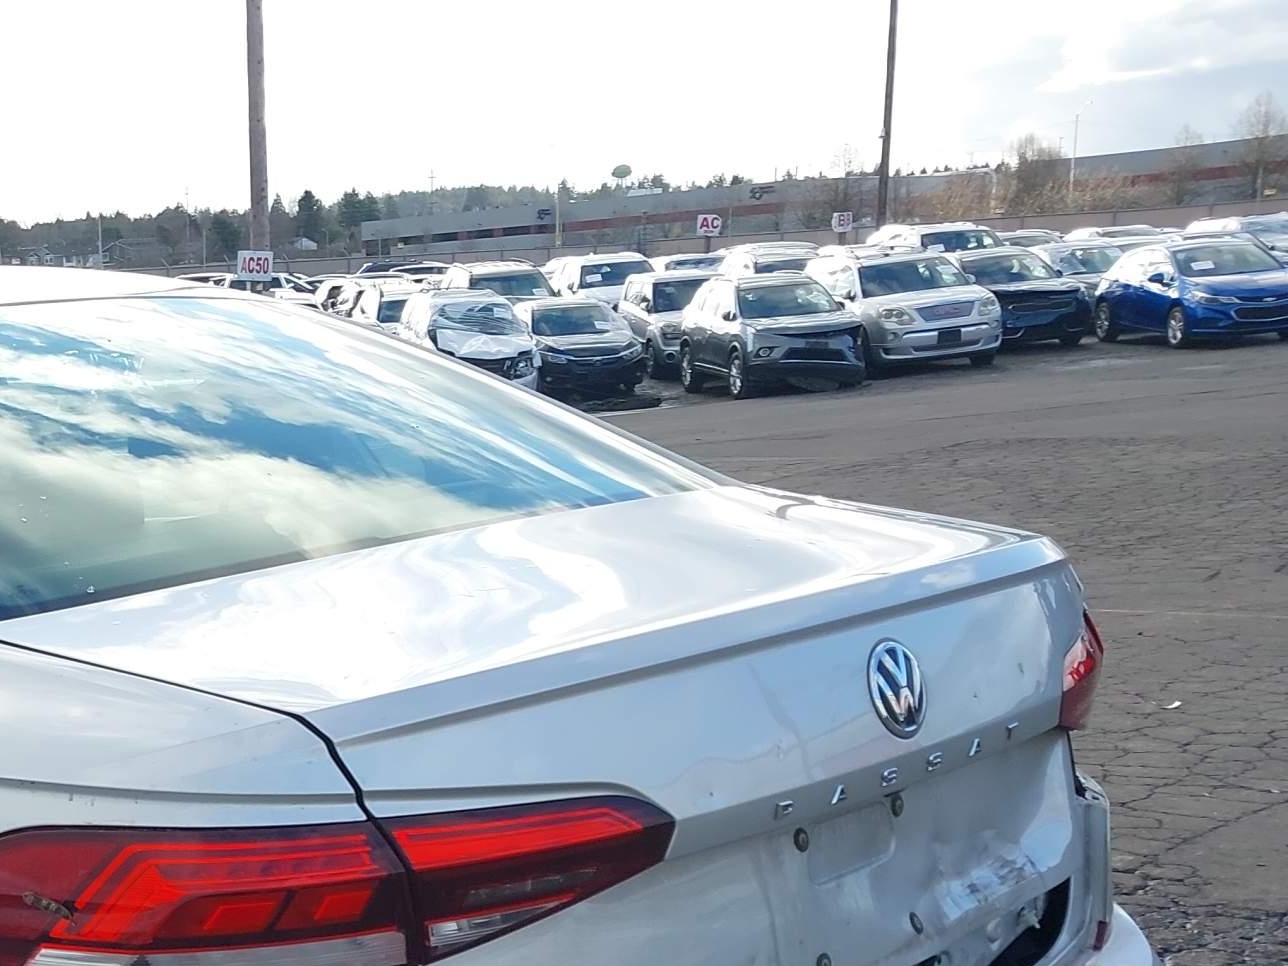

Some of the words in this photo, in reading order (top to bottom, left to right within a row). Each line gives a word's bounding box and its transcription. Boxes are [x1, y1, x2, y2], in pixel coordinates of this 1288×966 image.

[699, 217, 721, 229] AC
[241, 257, 270, 274] AC50
[868, 638, 926, 738] VW
[775, 722, 1019, 820] PASSAT
